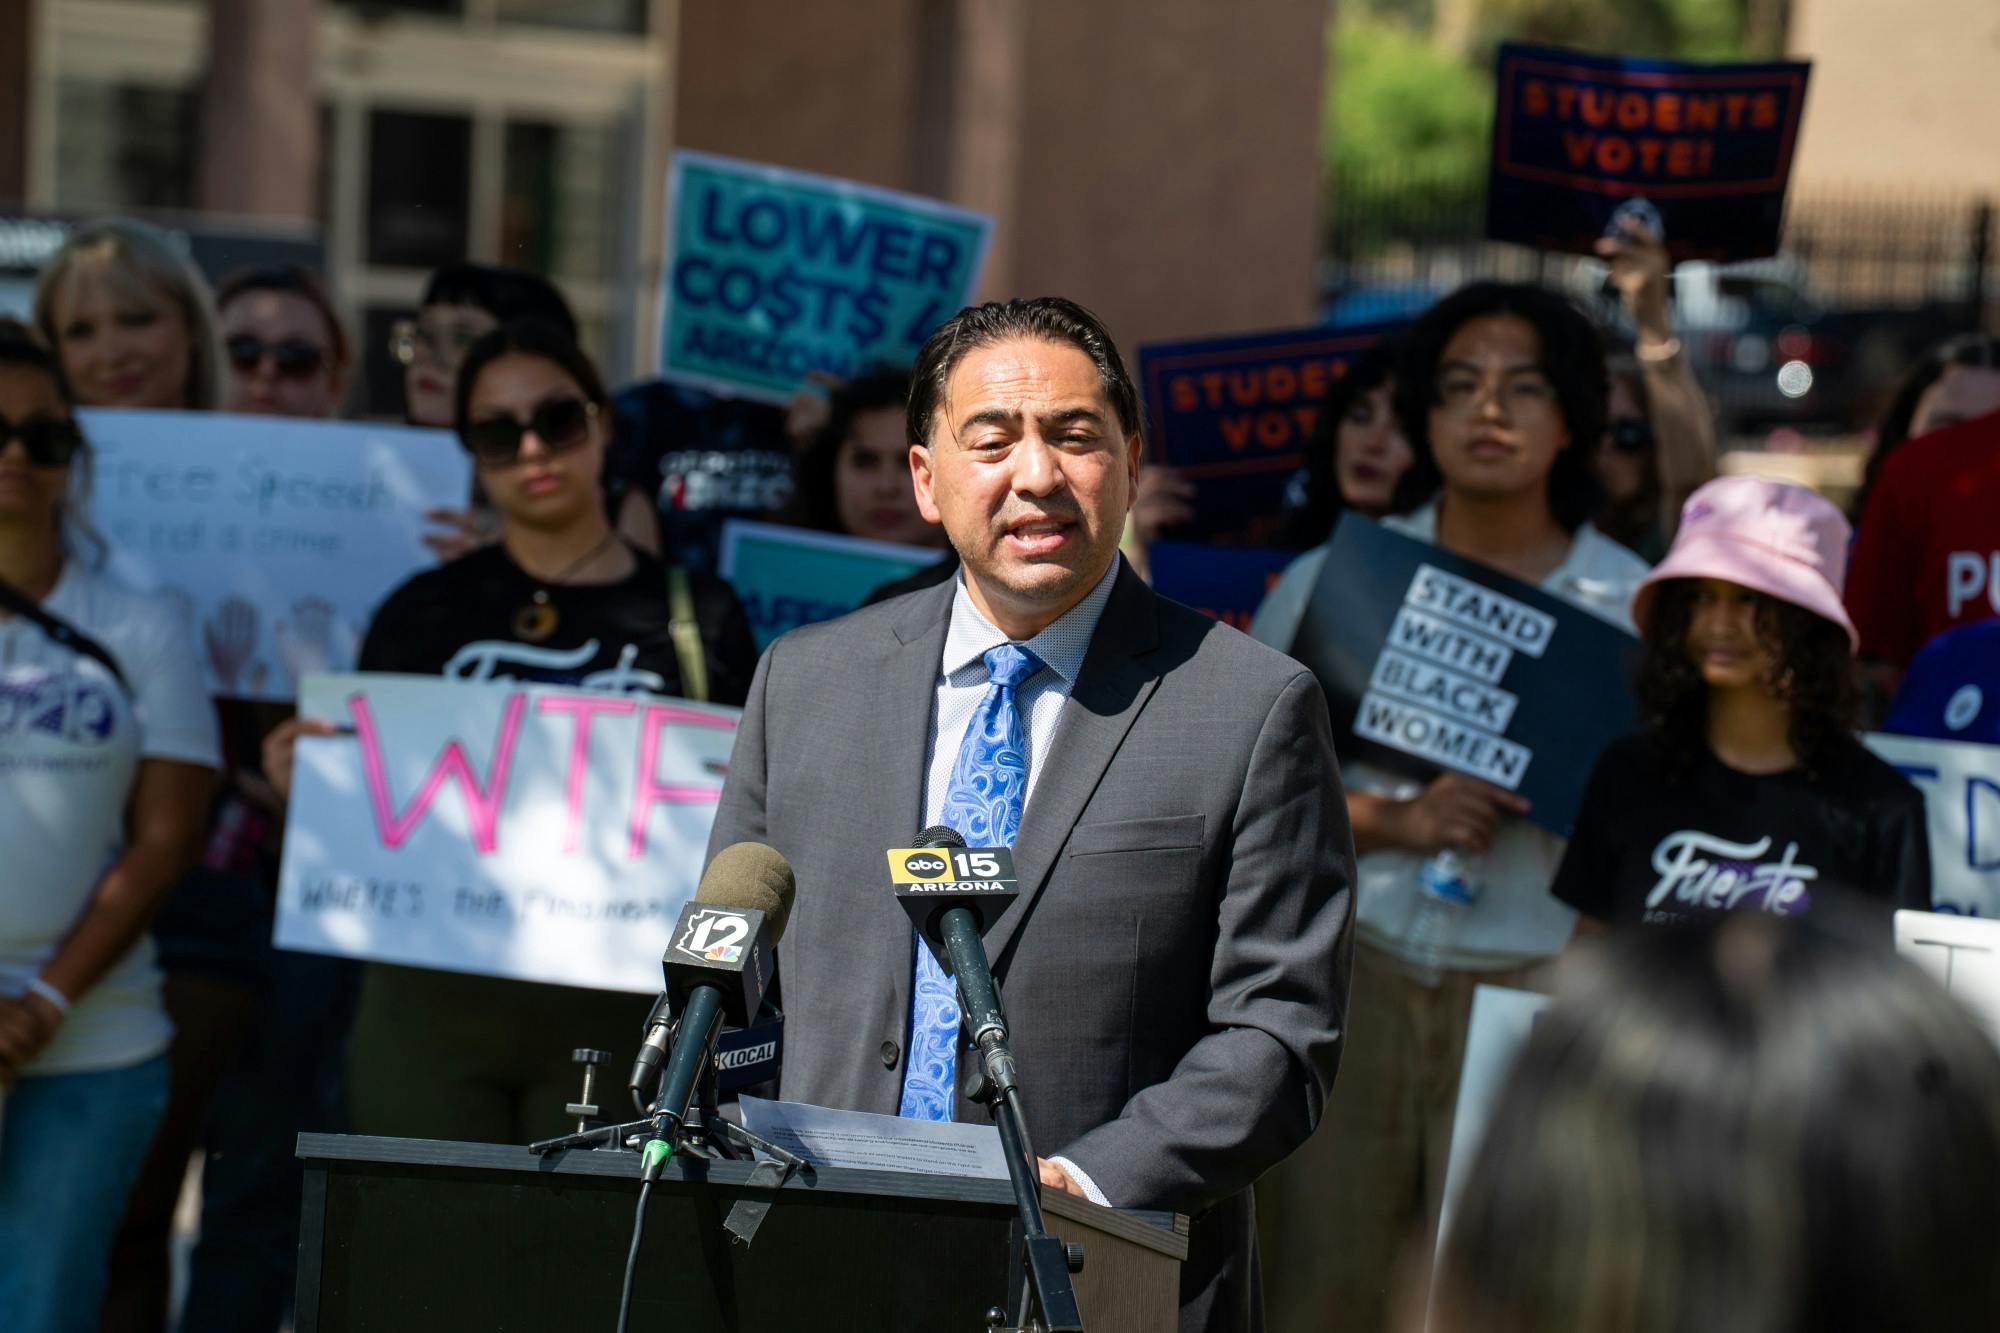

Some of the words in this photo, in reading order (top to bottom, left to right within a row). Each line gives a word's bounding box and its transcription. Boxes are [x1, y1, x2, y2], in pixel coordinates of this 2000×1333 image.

[1522, 79, 1778, 132] STUDENTS
[1562, 130, 1714, 176] VOTE!
[704, 187, 960, 290] LOWER
[1416, 577, 1542, 643] STAND
[1400, 616, 1501, 674] WITH
[1380, 658, 1503, 723] BLACK
[1367, 702, 1521, 776] WOMEN
[349, 691, 738, 858] WTF
[907, 860, 945, 871] abc
[954, 853, 1000, 877] 15
[909, 881, 1005, 892] ARIZONA
[1645, 830, 1819, 915] Fuerte
[688, 916, 750, 954] 12
